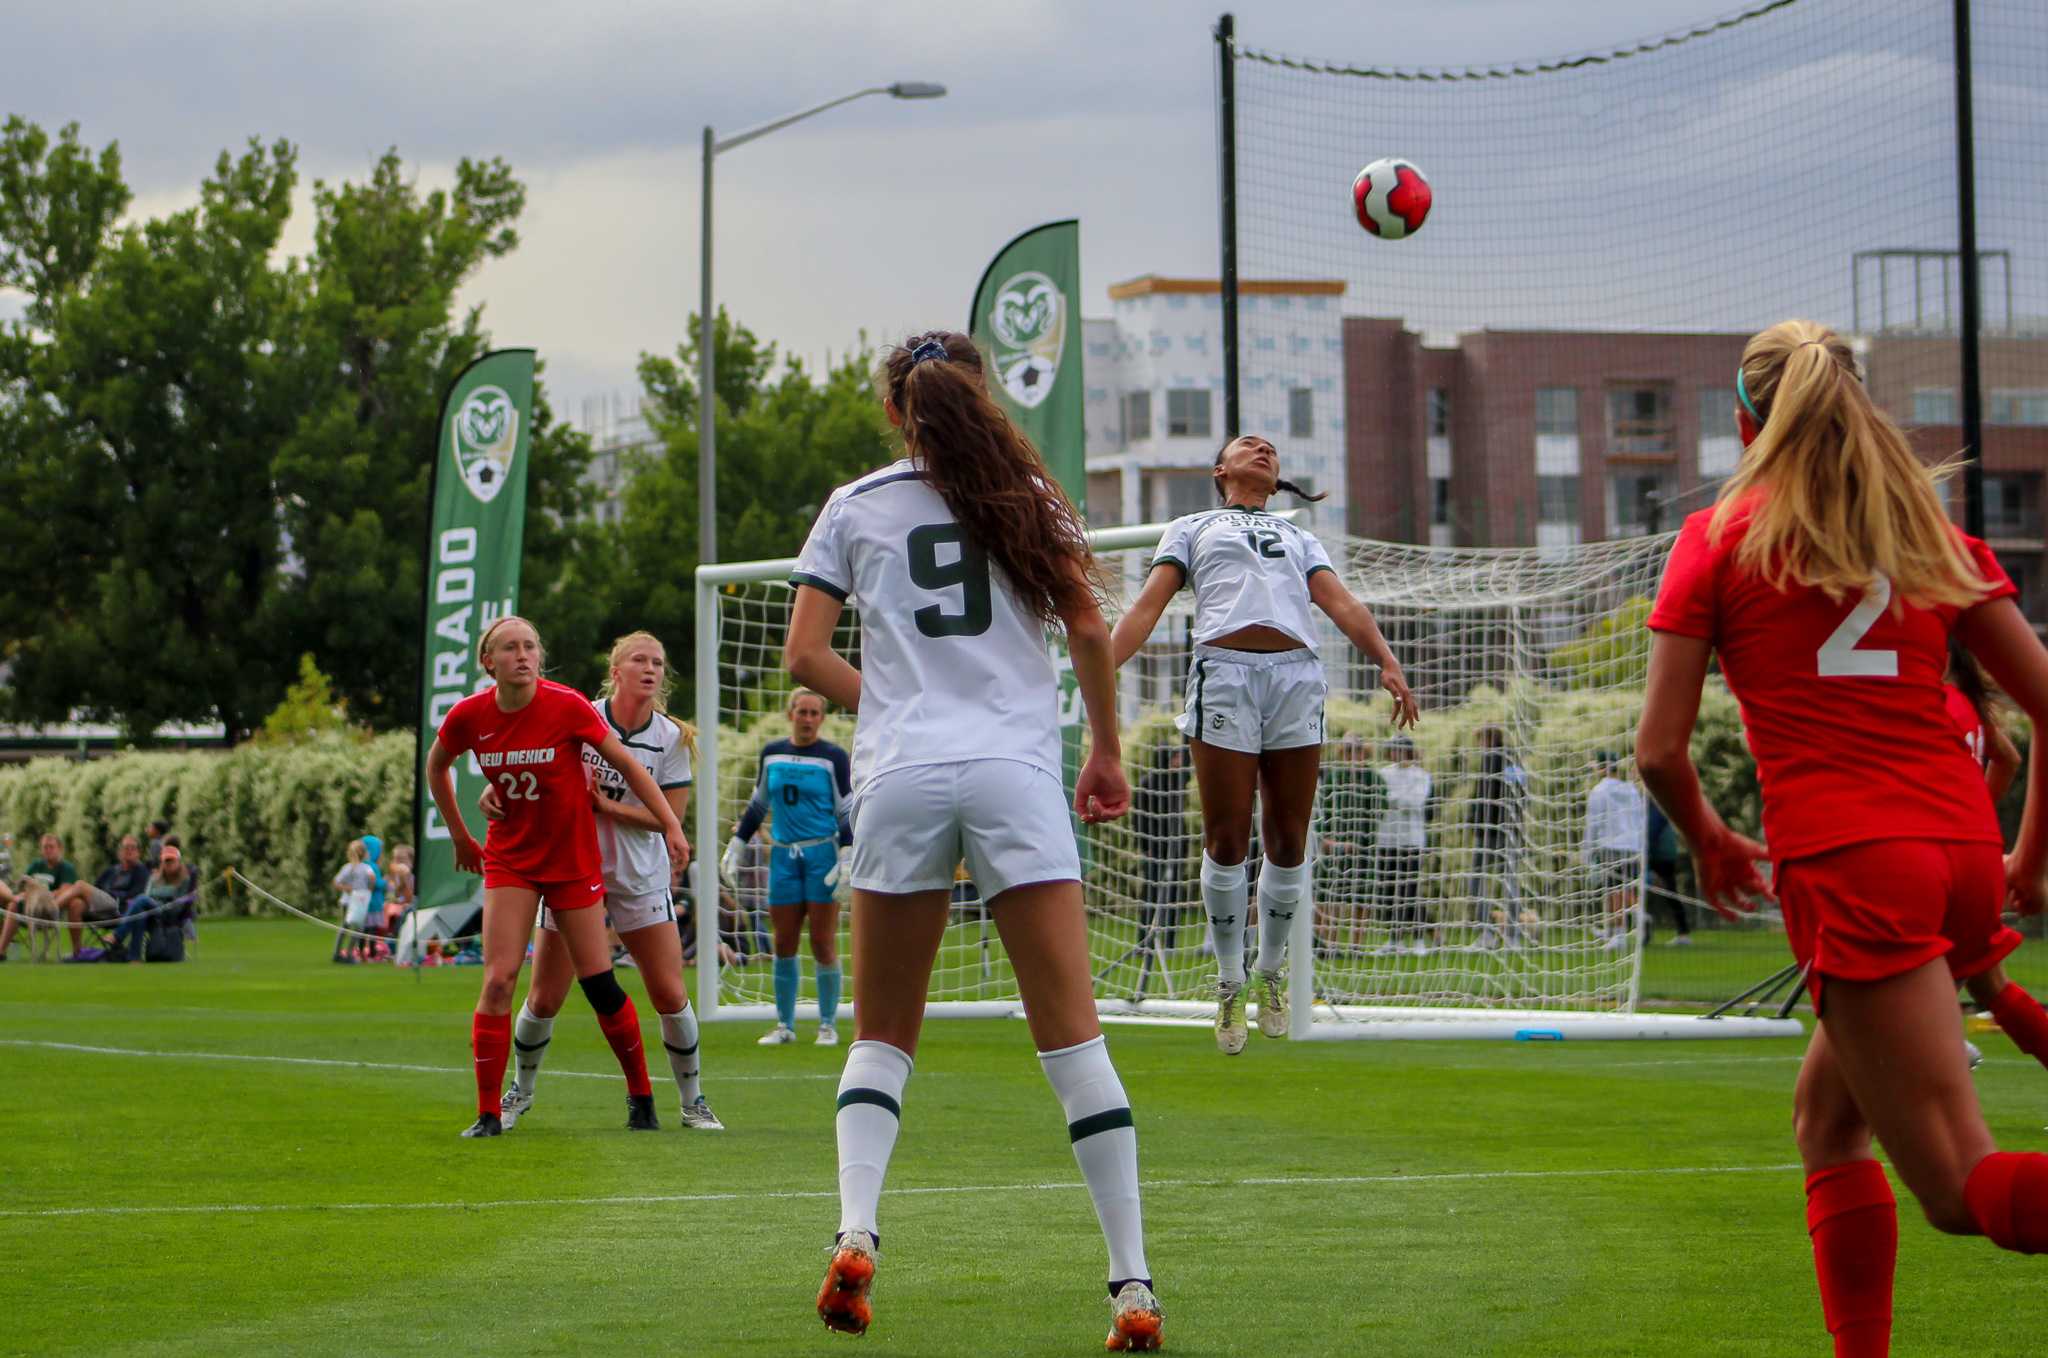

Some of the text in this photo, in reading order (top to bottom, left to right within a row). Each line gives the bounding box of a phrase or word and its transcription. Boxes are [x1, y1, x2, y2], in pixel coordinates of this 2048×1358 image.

[1240, 530, 1286, 558] 12
[907, 522, 992, 638] 9
[1816, 568, 1898, 677] 2
[480, 747, 555, 767] NEW MEXICO
[498, 771, 540, 800] 22
[783, 783, 799, 806] 0
